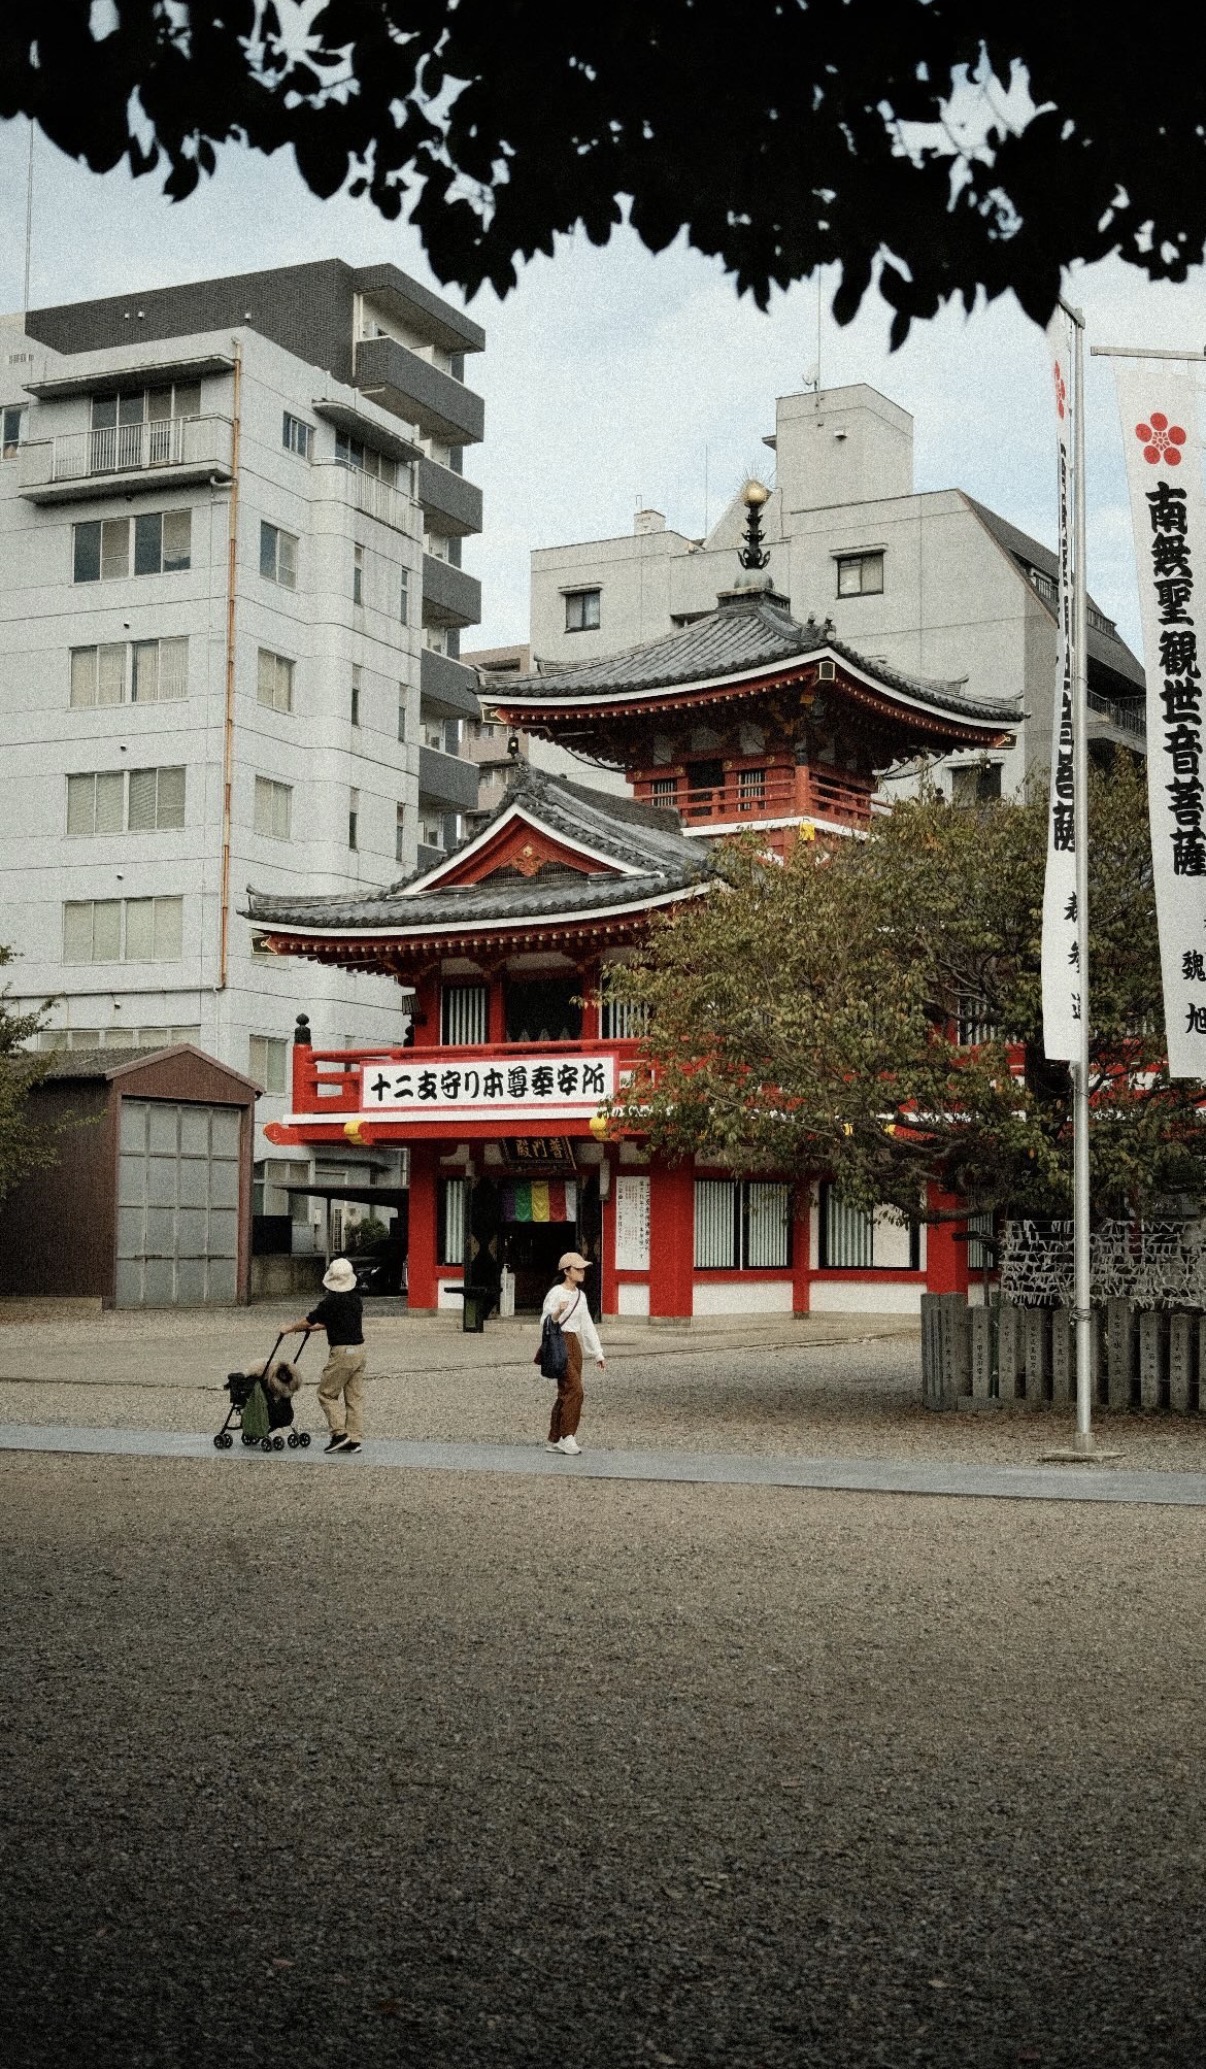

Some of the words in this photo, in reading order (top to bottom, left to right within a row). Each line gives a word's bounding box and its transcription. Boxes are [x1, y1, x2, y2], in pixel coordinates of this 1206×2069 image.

[1145, 481, 1206, 877] 南無聖観世音菩薩
[370, 1063, 606, 1102] 十二支守り本尊奉安所
